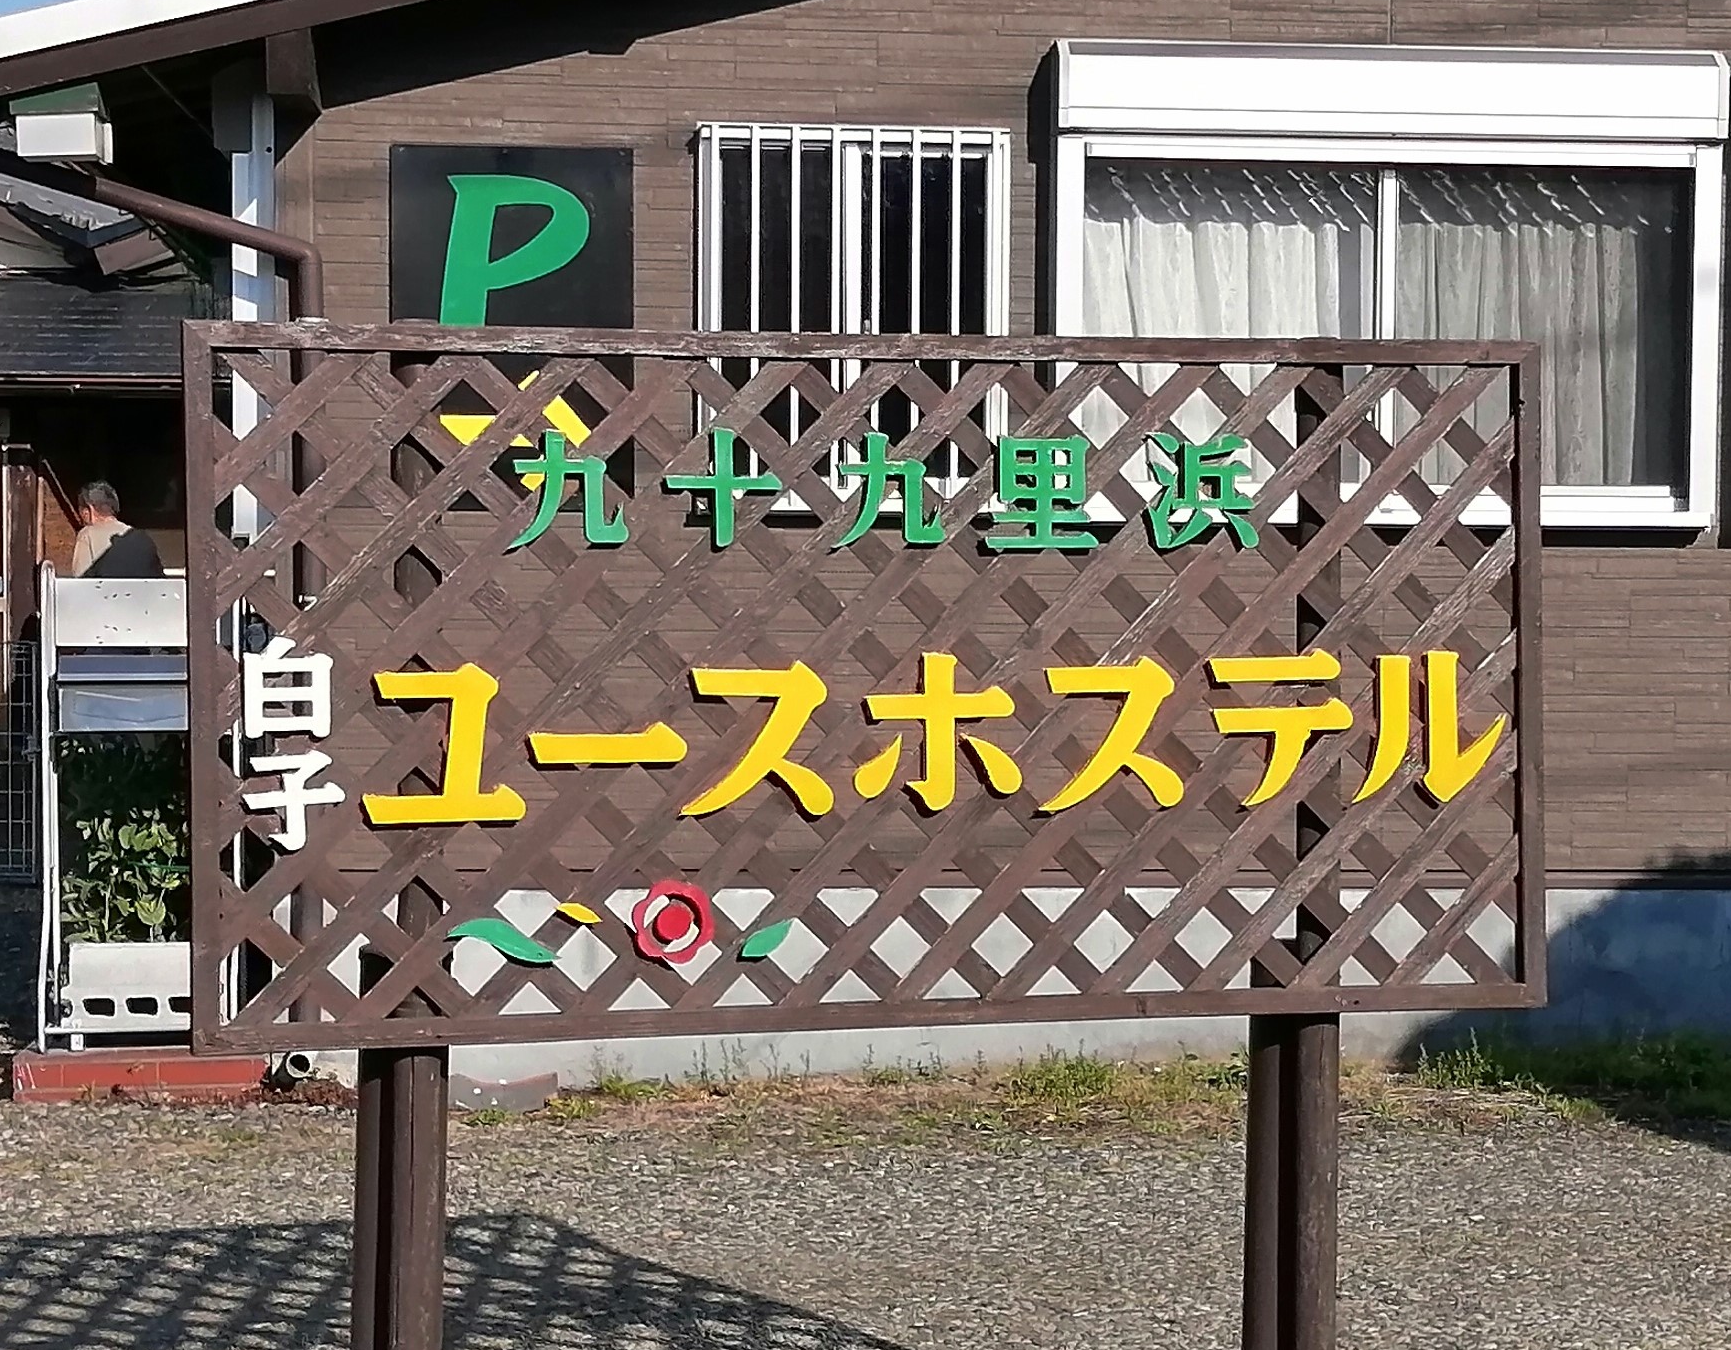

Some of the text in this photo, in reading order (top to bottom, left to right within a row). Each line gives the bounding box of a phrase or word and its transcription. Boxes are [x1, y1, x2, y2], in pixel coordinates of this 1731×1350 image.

[439, 173, 591, 328] P
[509, 429, 1260, 551] 九十九里浜
[241, 635, 347, 852] 白子
[362, 650, 1506, 825] ユースホステル
